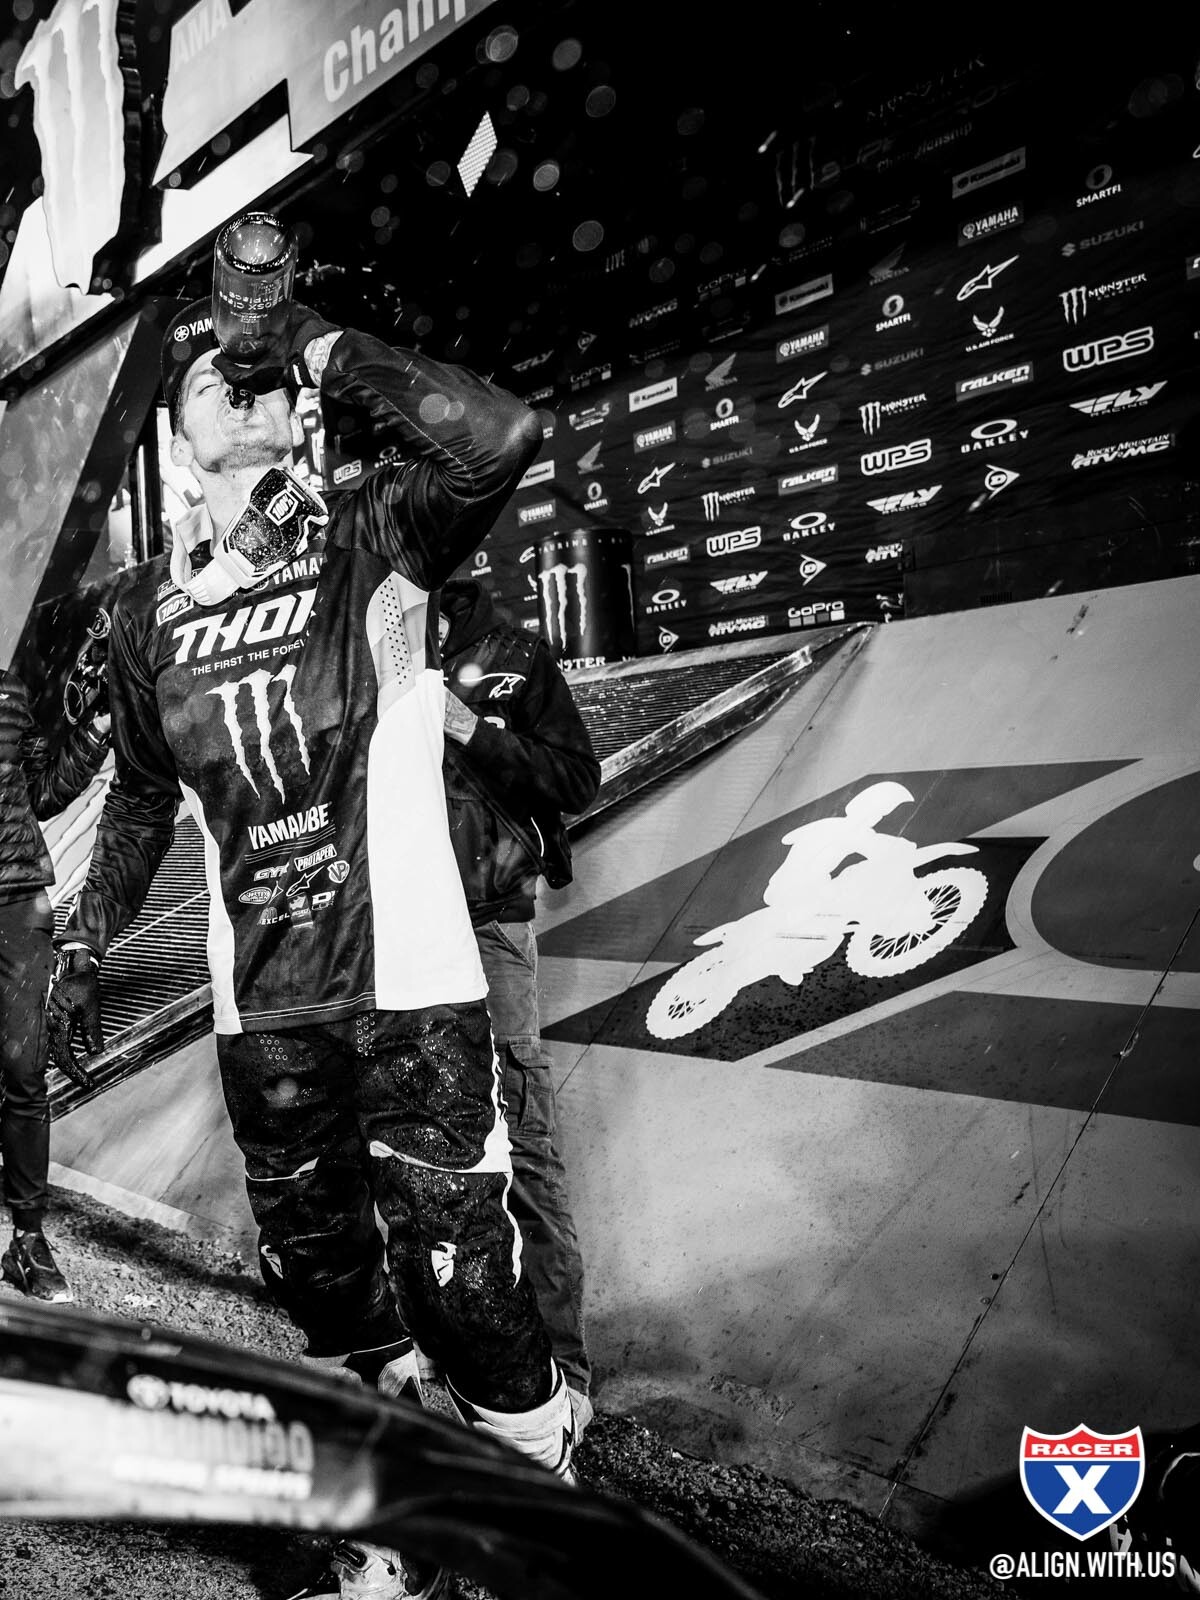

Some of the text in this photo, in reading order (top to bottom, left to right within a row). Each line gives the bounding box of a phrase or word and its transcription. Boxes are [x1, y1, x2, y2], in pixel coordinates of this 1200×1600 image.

[323, 0, 468, 103] Cham
[975, 206, 1019, 232] YAMAHA
[1079, 220, 1144, 250] SUZUKI
[1088, 273, 1148, 298] MONSTER
[189, 317, 214, 337] YAM
[1063, 326, 1155, 373] WPS
[960, 365, 1030, 393] FALKEN
[960, 429, 1029, 454] OAKLEY
[860, 438, 932, 477] WPS
[705, 526, 762, 557] WPS
[783, 522, 837, 542] OAKLEY
[272, 557, 324, 585] YAMA
[788, 600, 844, 618] GoPro
[192, 664, 213, 677] THE
[213, 655, 243, 672] FIRST
[247, 648, 270, 662] THE
[556, 655, 606, 673] NSTER
[248, 803, 329, 851] YAMABE
